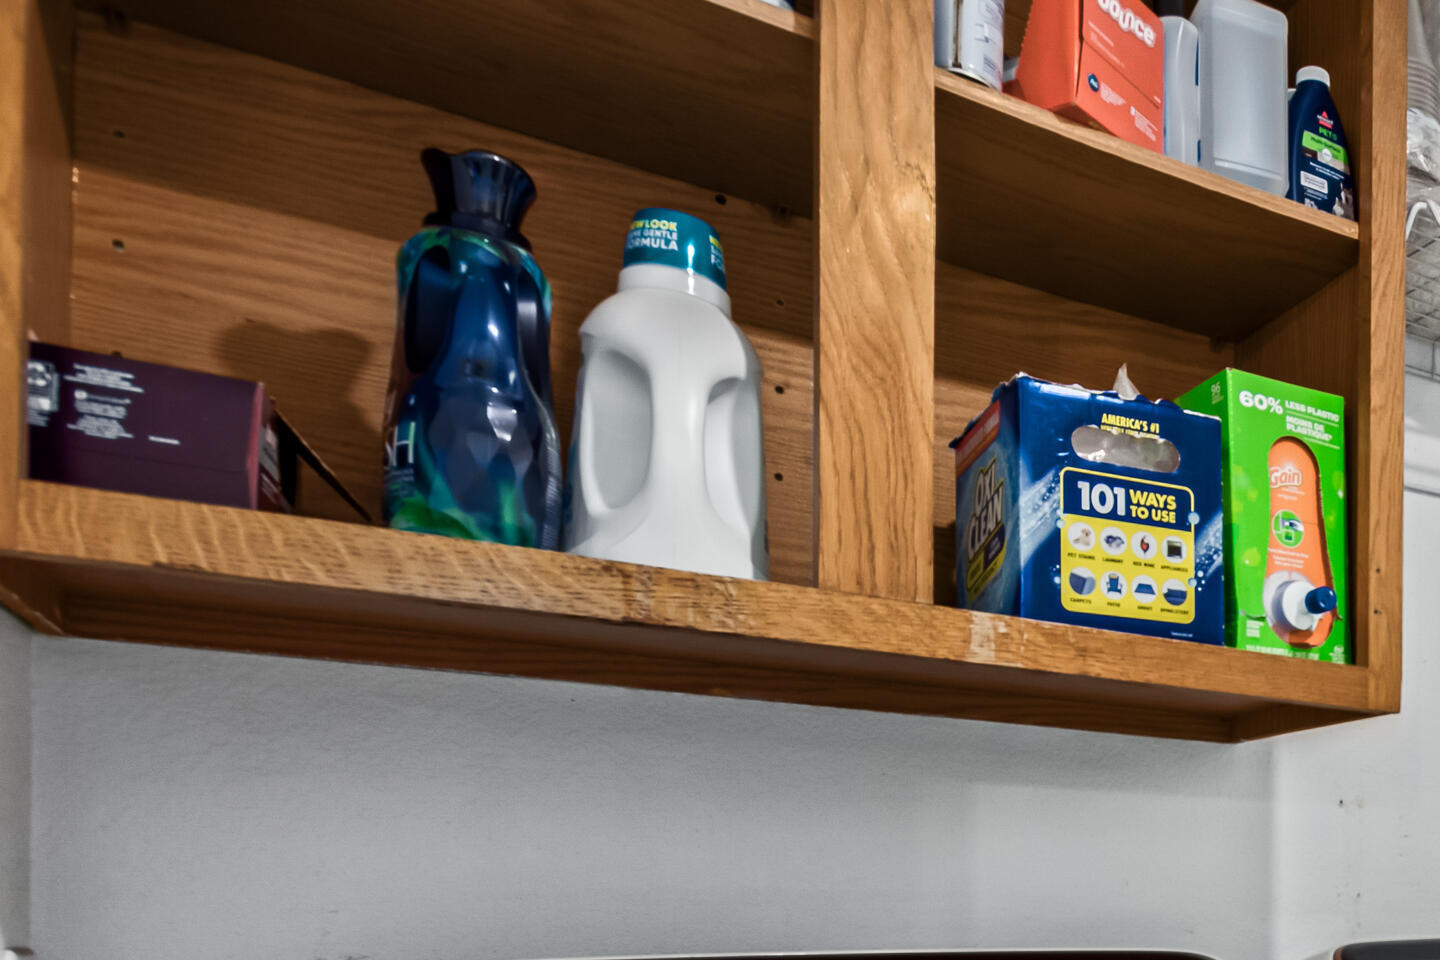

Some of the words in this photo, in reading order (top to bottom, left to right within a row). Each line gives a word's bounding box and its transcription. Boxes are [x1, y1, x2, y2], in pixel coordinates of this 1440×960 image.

[643, 229, 678, 241] GENTLE
[644, 219, 678, 232] LOOK
[1239, 390, 1284, 415] 60%
[1285, 400, 1306, 413] LESS
[1307, 406, 1340, 422] PLASTIC
[1101, 413, 1149, 432] AMERICA'S
[1149, 422, 1160, 434] #1
[975, 457, 997, 514] OXI
[1269, 463, 1303, 489] Gain
[1077, 480, 1126, 516] 101
[1128, 488, 1177, 511] WAYS
[968, 479, 1004, 561] CLEAN
[1129, 505, 1149, 520] TO
[1151, 508, 1176, 524] USE
